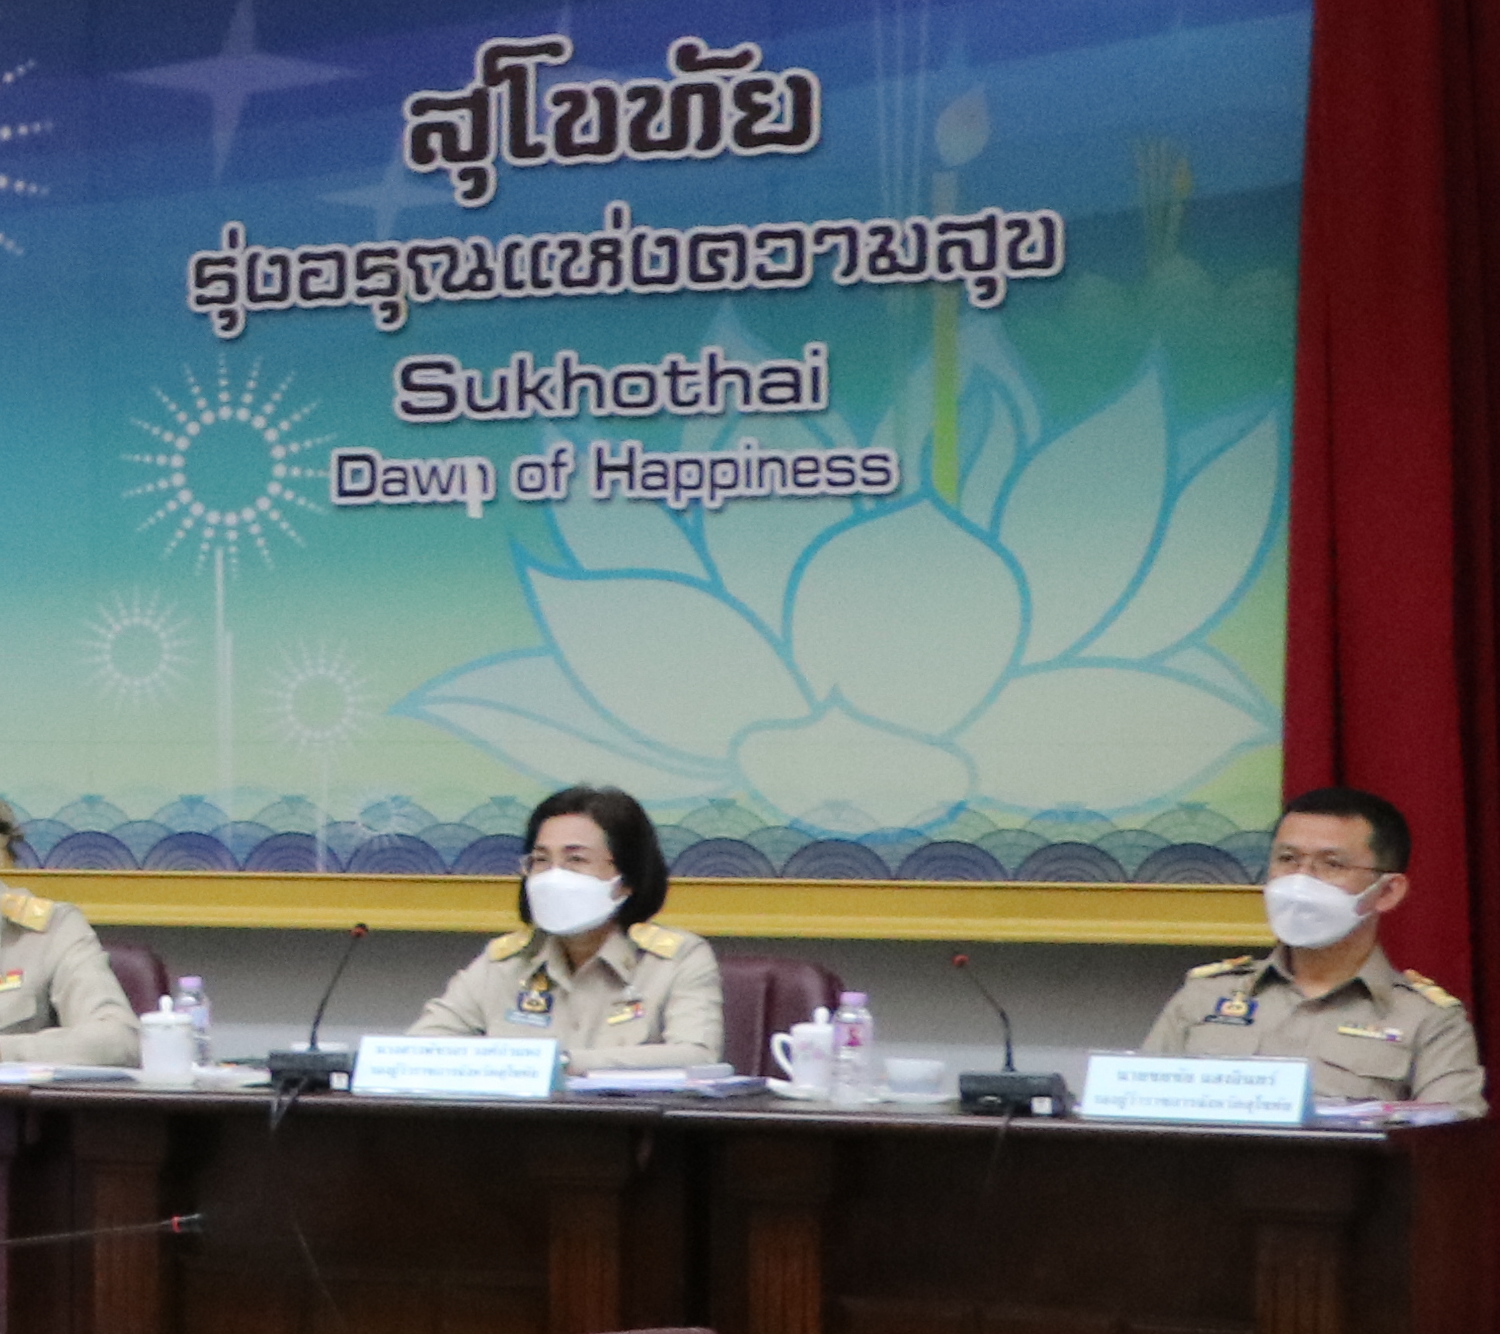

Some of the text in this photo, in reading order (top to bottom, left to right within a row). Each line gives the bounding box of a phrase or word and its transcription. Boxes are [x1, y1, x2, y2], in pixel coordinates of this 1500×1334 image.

[409, 41, 816, 199] สุโขทัย
[192, 208, 1061, 331] รุ่งอรุณแห่งความสุข
[398, 349, 826, 419] Sukhothai
[337, 443, 894, 503] Dawn of Happiness
